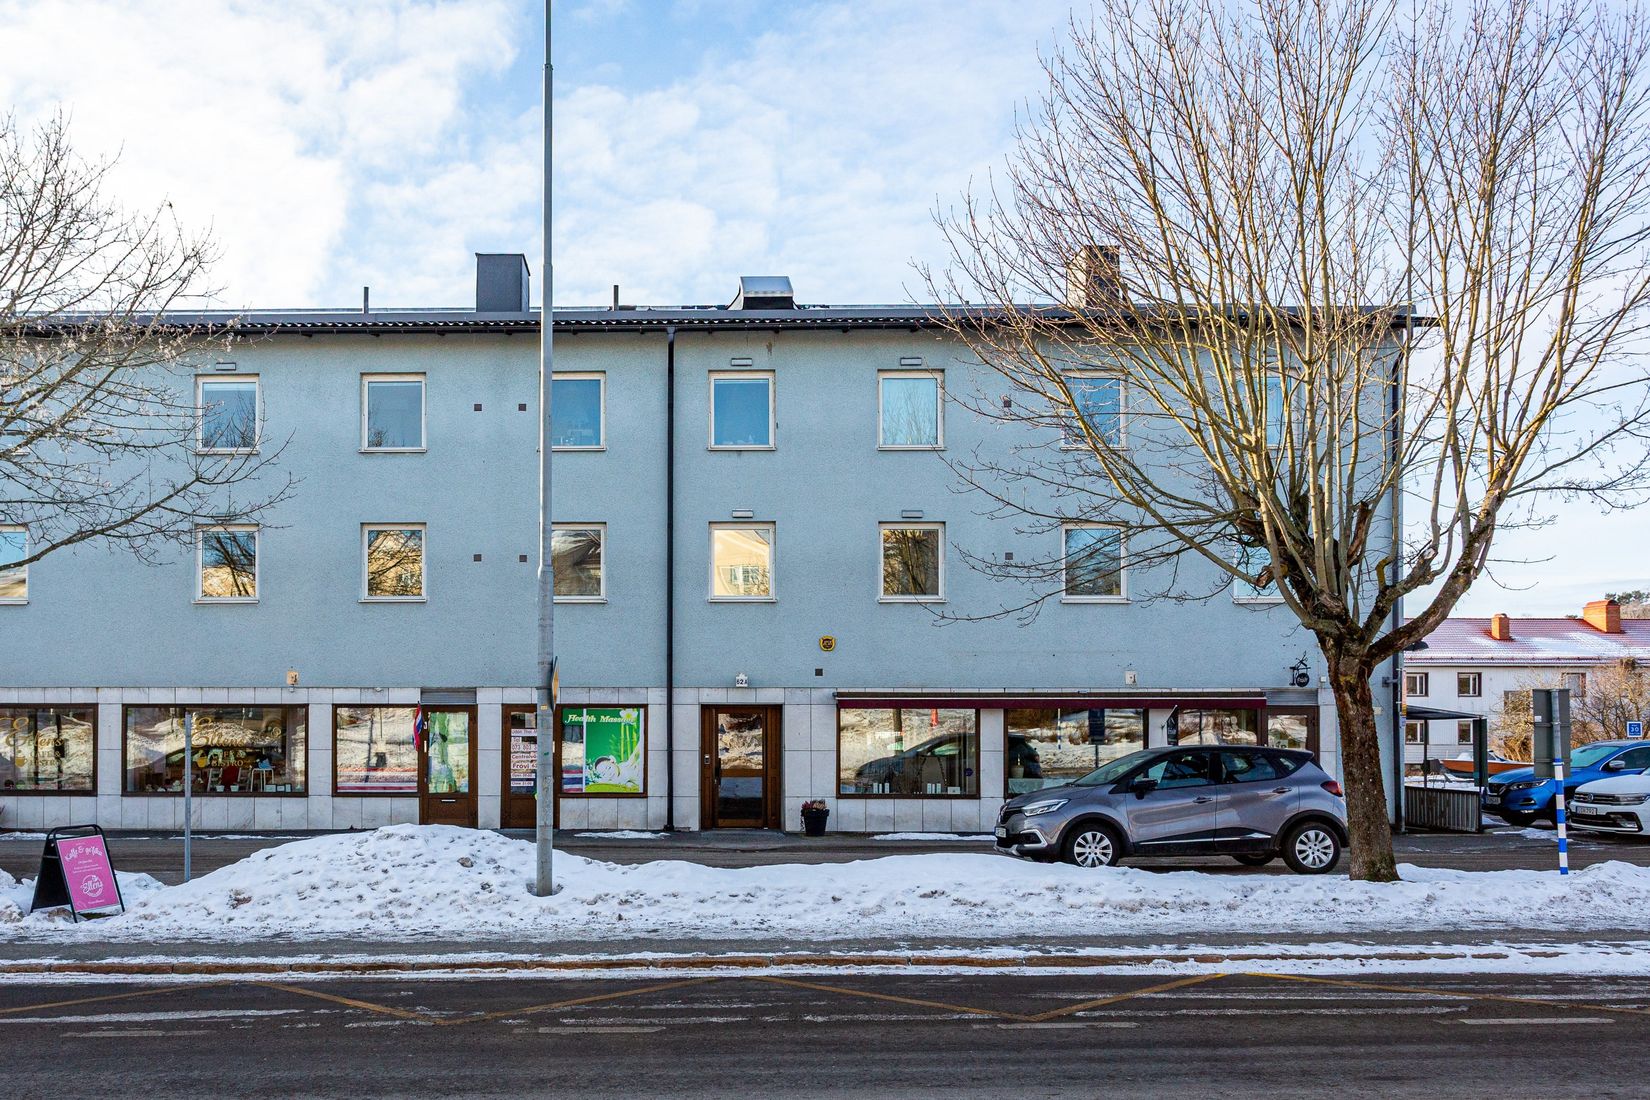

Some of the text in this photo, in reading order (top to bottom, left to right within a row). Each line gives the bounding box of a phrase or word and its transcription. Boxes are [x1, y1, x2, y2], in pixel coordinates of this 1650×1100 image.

[565, 714, 596, 723] Health
[191, 717, 245, 748] Ellens
[81, 879, 104, 893] Ellens
